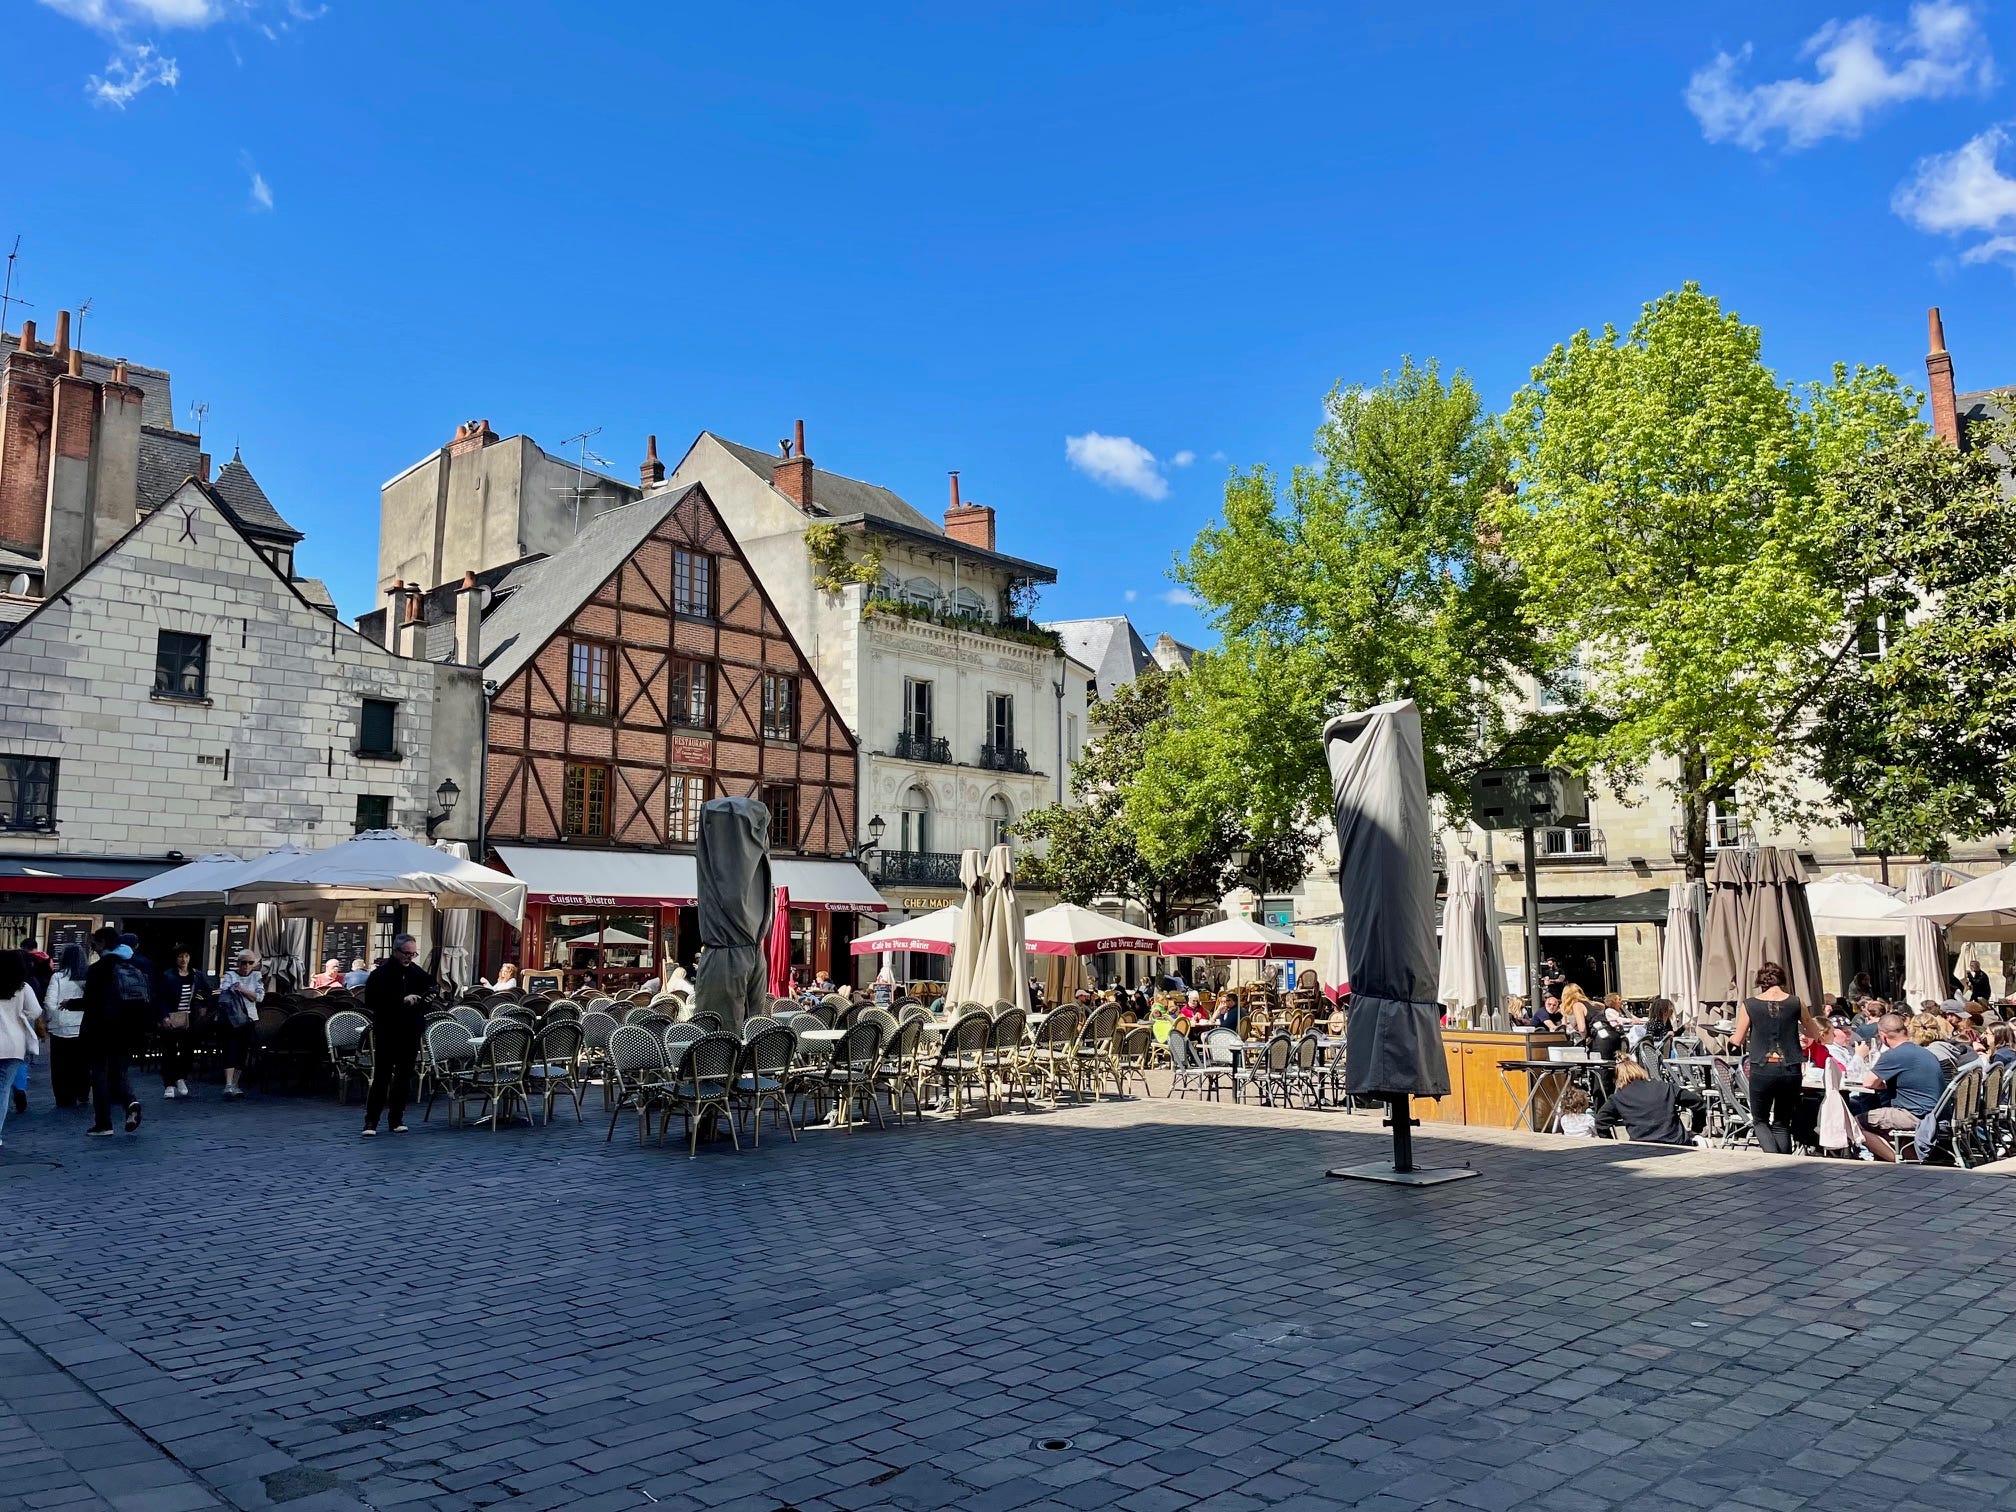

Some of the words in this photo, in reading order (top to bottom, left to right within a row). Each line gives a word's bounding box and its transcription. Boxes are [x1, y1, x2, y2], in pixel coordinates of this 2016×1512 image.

[674, 737, 709, 748] RESTAURANT
[548, 894, 583, 904] Cuisine
[583, 895, 616, 905] Bistrot
[903, 898, 927, 909] CHEZ
[824, 902, 850, 911] Cuisine
[850, 903, 873, 912] Bistrot
[871, 940, 884, 950] Café
[884, 941, 892, 949] du
[892, 940, 909, 949] Vieux
[1096, 940, 1109, 950] Café
[1110, 940, 1118, 949] du
[1118, 939, 1134, 948] Vieux
